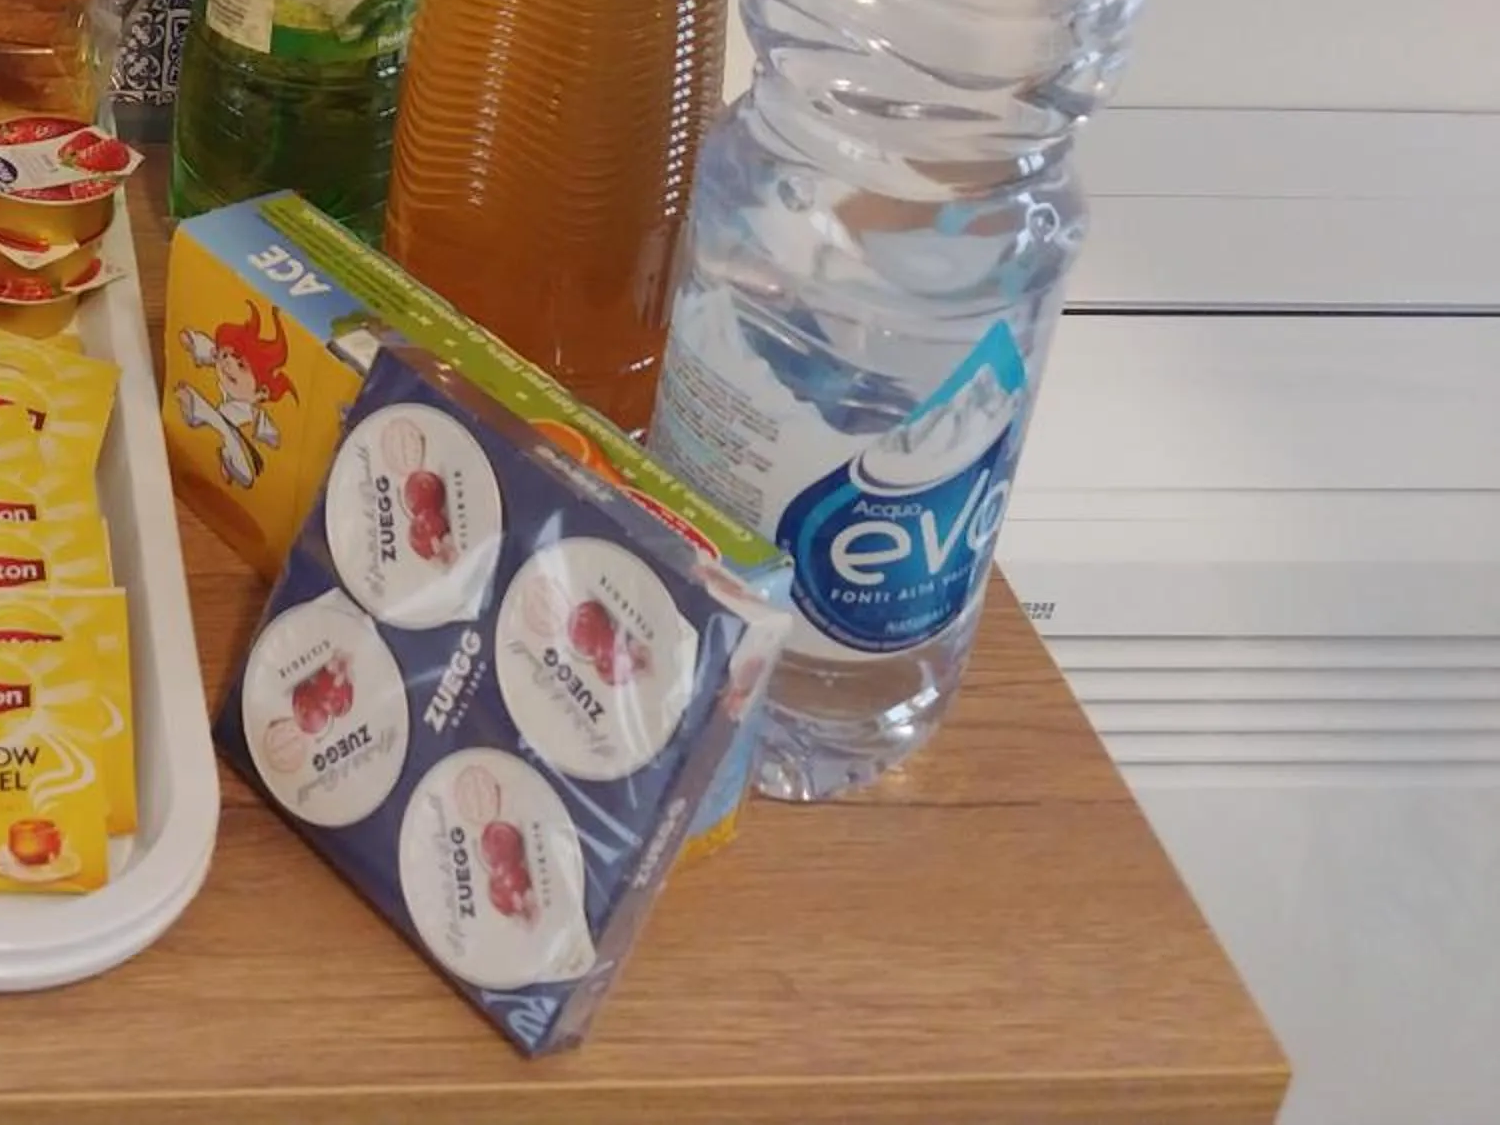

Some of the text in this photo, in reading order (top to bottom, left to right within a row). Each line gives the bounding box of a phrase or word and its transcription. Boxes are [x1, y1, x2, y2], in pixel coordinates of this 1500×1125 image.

[248, 244, 331, 296] ACE
[376, 476, 397, 563] ZUEGG
[852, 499, 923, 521] Acqua
[423, 629, 482, 735] ZUEGG
[543, 646, 606, 724] ZUEGG
[312, 725, 373, 772] ZUEGG
[451, 826, 476, 919] ZUEGG
